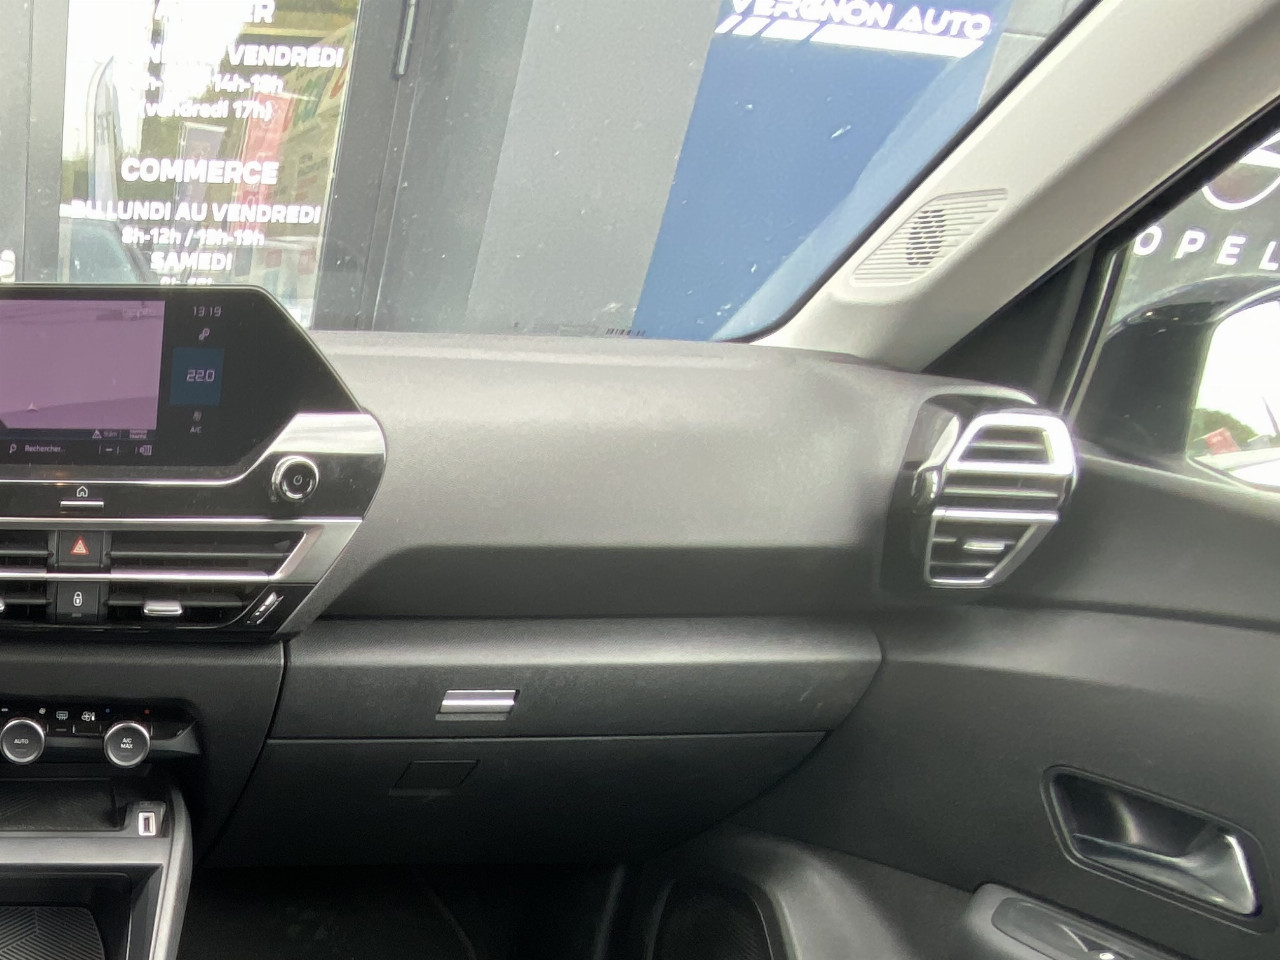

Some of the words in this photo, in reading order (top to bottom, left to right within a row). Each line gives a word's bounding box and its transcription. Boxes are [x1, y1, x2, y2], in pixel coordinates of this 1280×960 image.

[898, 6, 992, 38] AUTO
[226, 44, 344, 68] VENDREDI
[121, 157, 280, 184] COMMERCE
[106, 200, 171, 221] LUNDI
[174, 202, 208, 221] AU
[212, 203, 321, 224] VENDREDI
[1133, 226, 1280, 271] OPEL
[151, 252, 232, 272] SAMEDI
